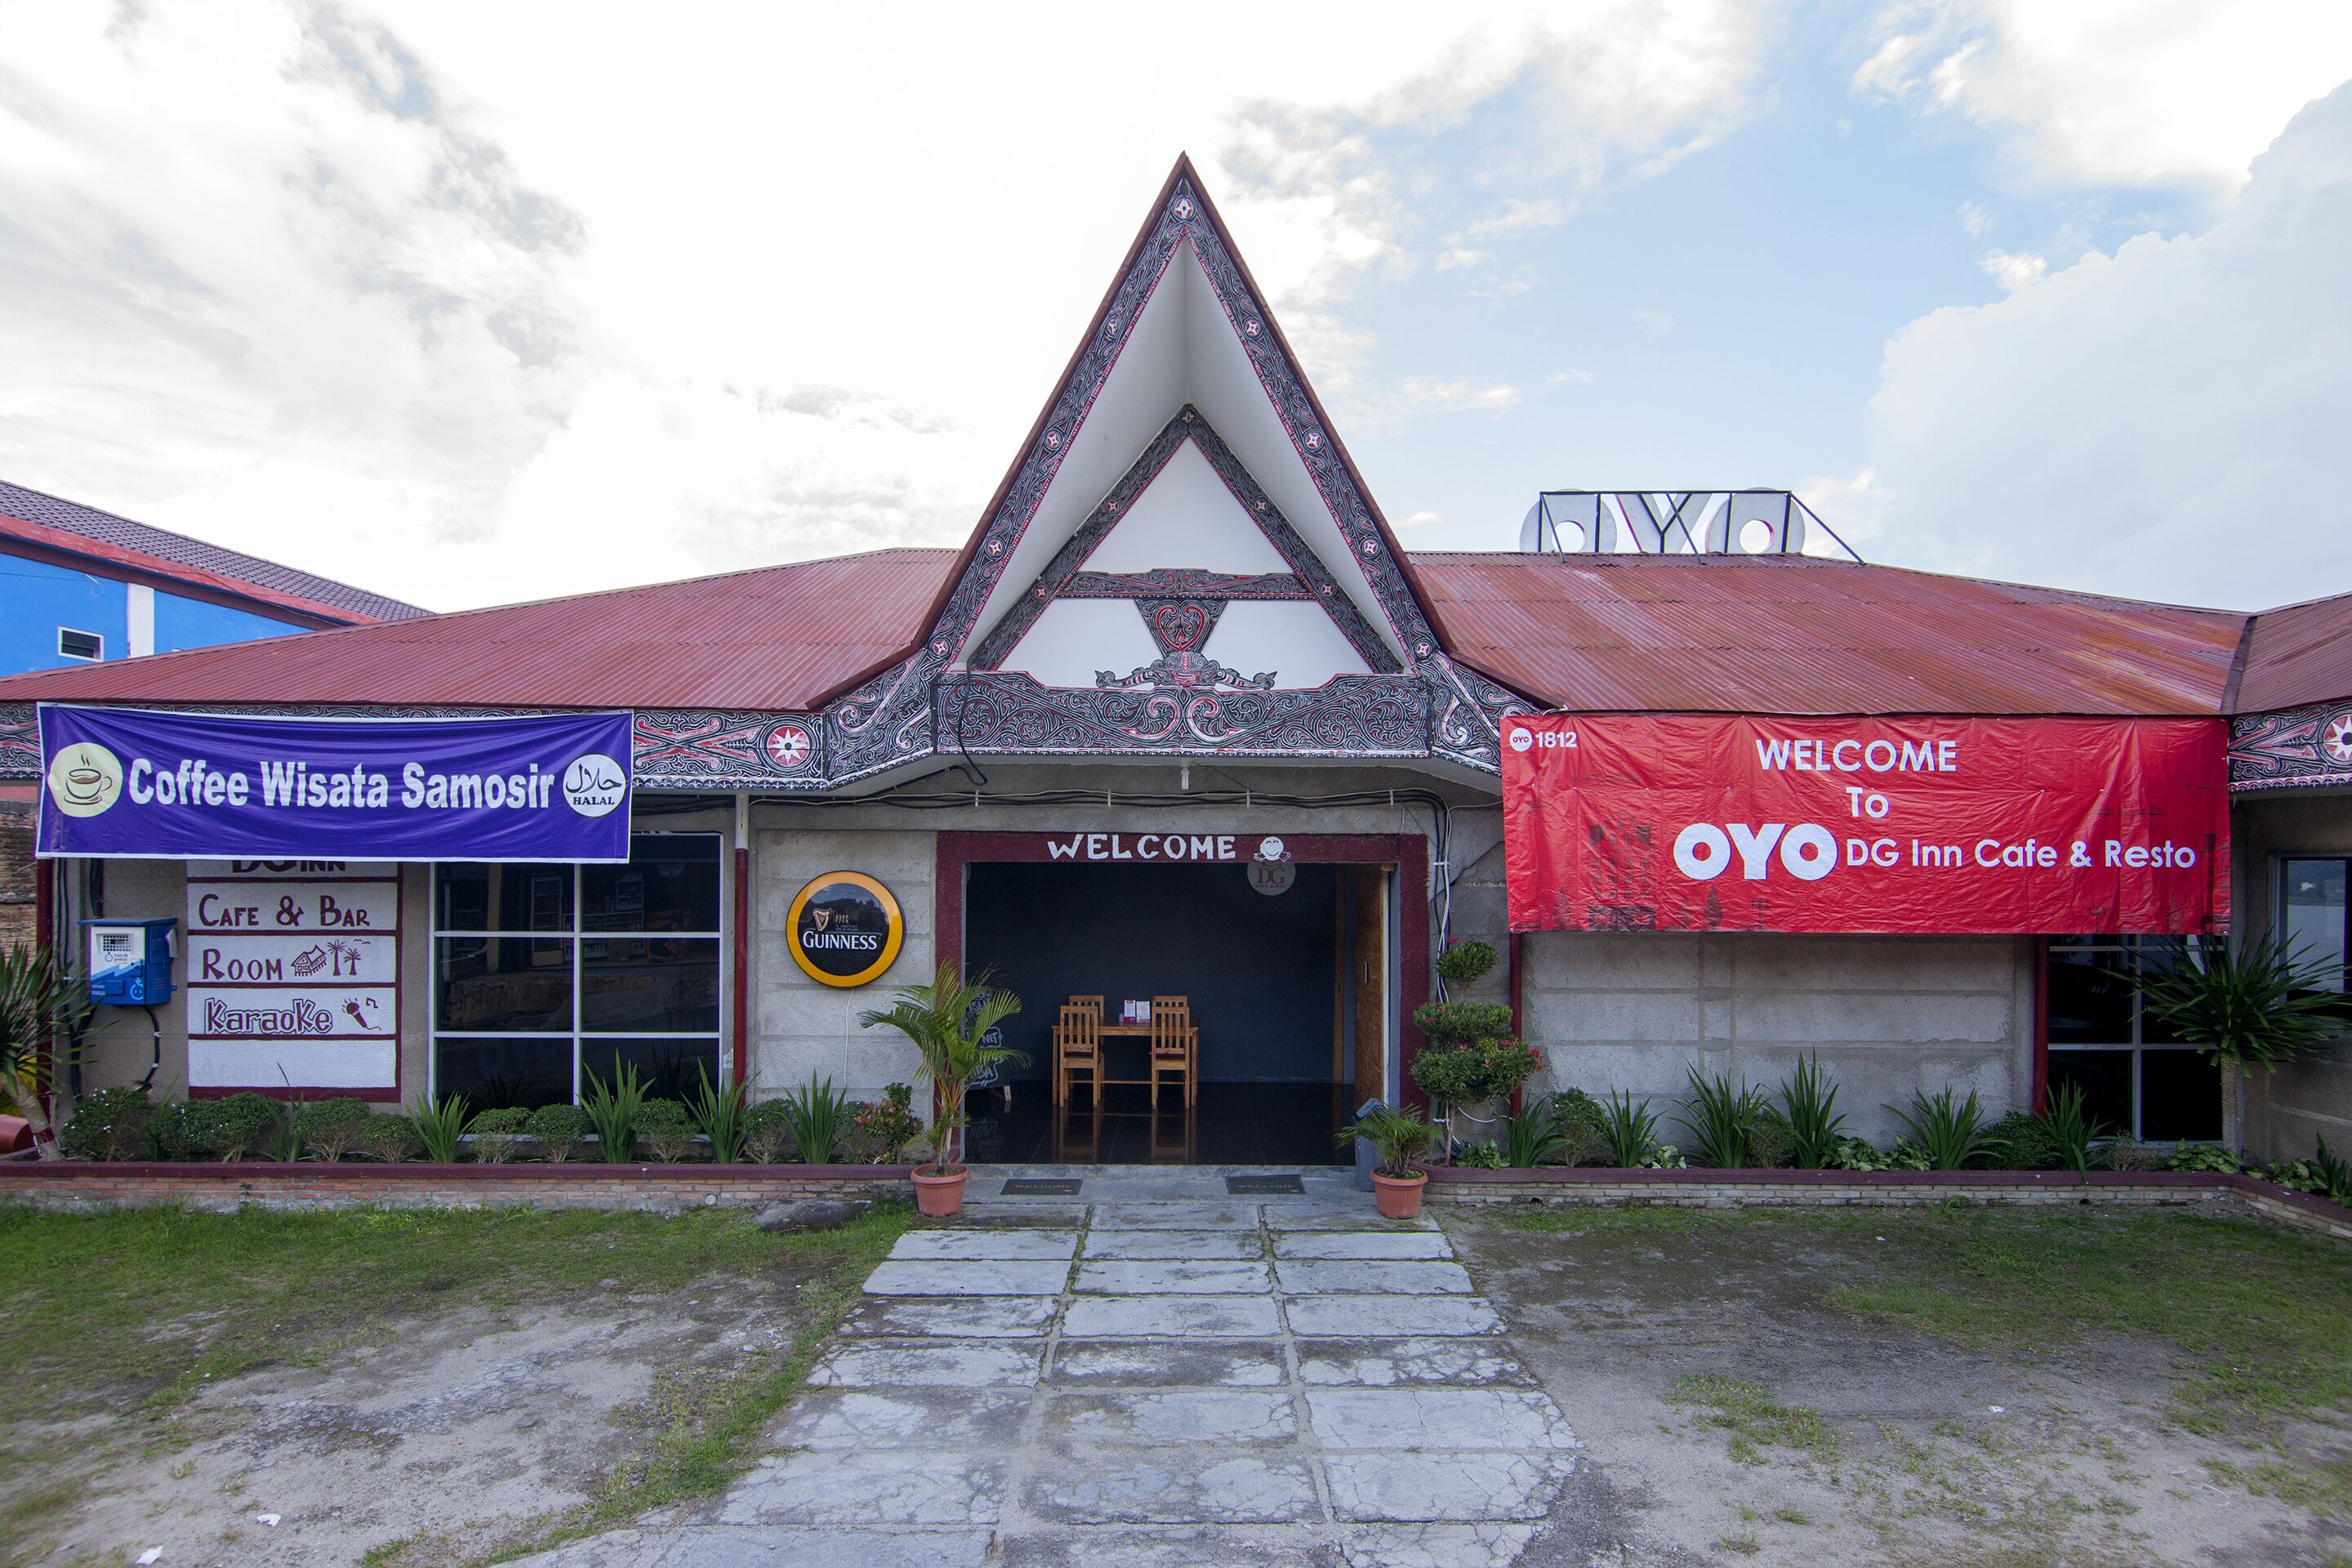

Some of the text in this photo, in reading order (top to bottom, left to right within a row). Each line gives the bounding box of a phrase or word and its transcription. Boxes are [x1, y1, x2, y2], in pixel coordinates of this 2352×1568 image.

[1535, 732, 1577, 748] 1812
[1756, 739, 1957, 773] WELCOME
[130, 759, 555, 809] Coffee Wisata Samosir
[572, 796, 615, 805] HALAL
[1846, 786, 1889, 818] To
[1048, 834, 1236, 860] WELCOME
[1673, 822, 2196, 881] OYO DG Inn Cafe & Resto
[1258, 867, 1285, 884] DG
[198, 893, 370, 927] CAFE & BAR
[802, 930, 878, 950] GUINNESS
[203, 948, 283, 980] ROOM
